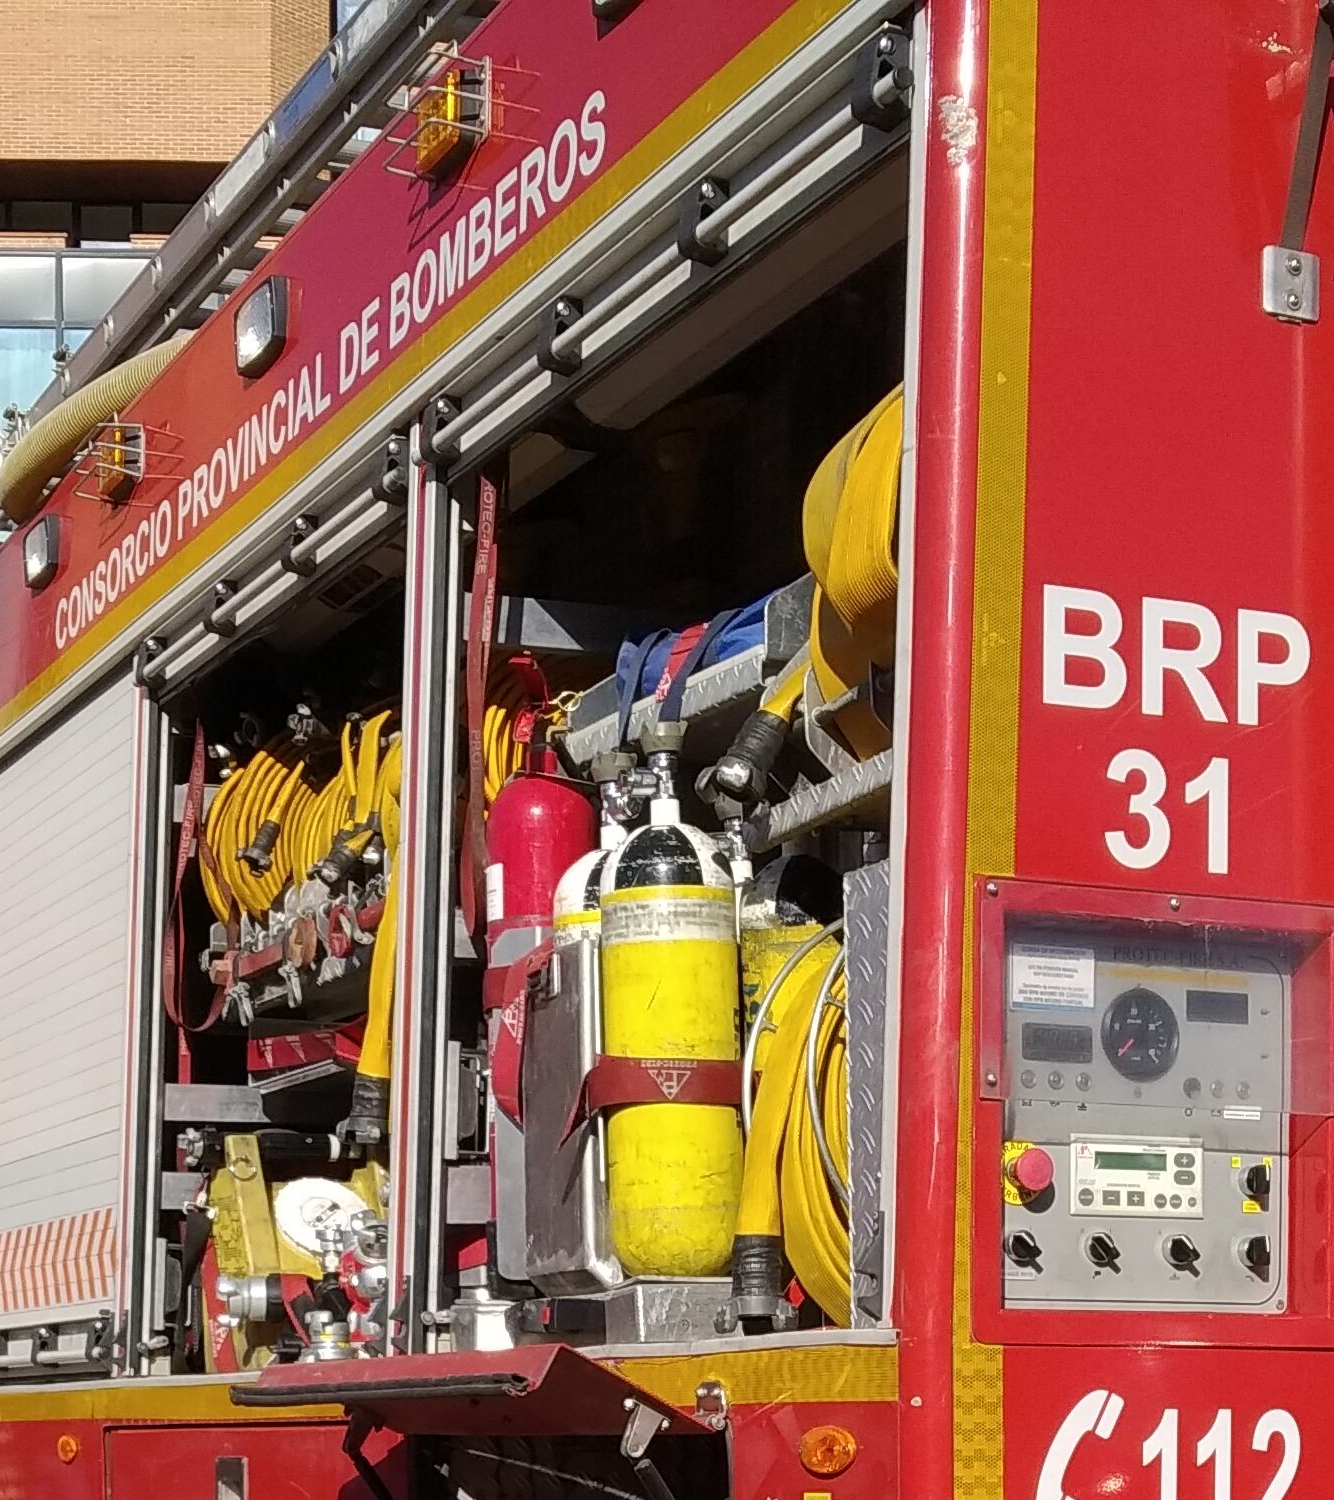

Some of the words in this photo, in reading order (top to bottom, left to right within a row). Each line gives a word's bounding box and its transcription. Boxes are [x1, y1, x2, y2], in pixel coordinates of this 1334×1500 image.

[55, 500, 172, 651] CONSORCIO
[177, 352, 332, 542] PROVINCIAL
[339, 297, 382, 394] DE
[390, 89, 607, 351] BOMBEROS
[1042, 583, 1312, 727] BRP
[1103, 747, 1231, 876] 31
